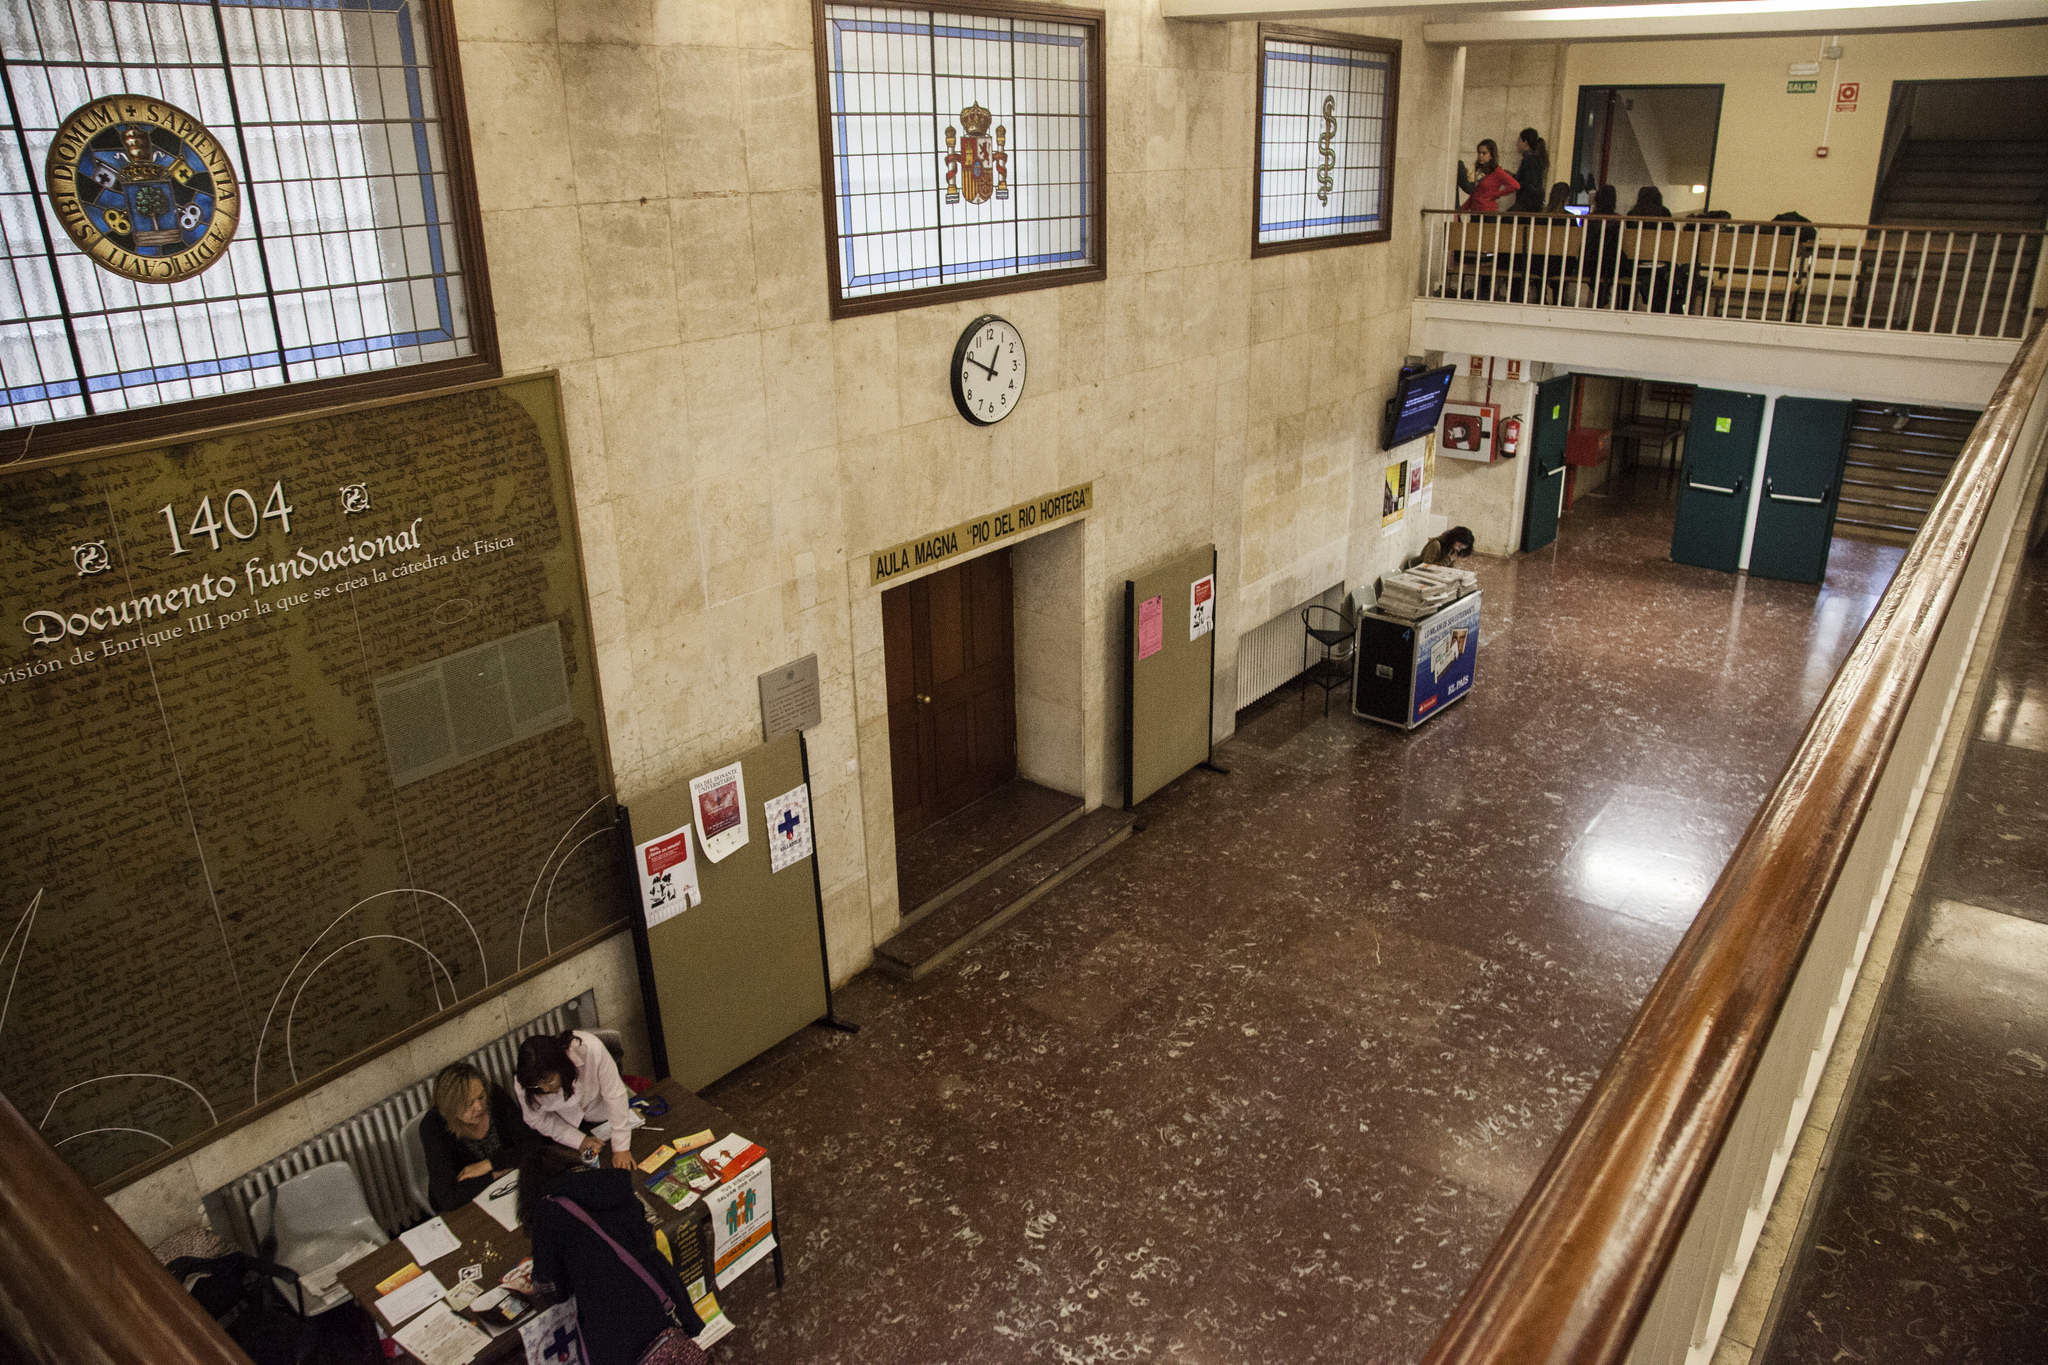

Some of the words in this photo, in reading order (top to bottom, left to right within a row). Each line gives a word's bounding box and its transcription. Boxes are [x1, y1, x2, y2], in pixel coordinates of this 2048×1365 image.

[1788, 82, 1817, 90] SALIDA
[54, 105, 114, 183] DOMUM
[147, 104, 235, 202] SAPIENTIA
[56, 191, 97, 241] SIBI
[157, 480, 293, 556] 1404
[876, 548, 910, 580] AULA
[914, 532, 958, 566] MAGNA
[995, 513, 1015, 538] DEL
[1019, 505, 1036, 529] RIO
[23, 573, 237, 645] Documento
[245, 518, 423, 595] fundacional
[0, 659, 65, 685] visión
[70, 647, 95, 666] de
[100, 624, 184, 657] Enrique
[188, 613, 212, 634] III
[219, 609, 250, 630] por
[254, 600, 271, 616] la
[276, 593, 309, 611] que
[314, 587, 331, 600] se
[335, 577, 368, 593] crea
[372, 568, 388, 584] la
[392, 552, 448, 578] cátedra
[451, 546, 470, 562] de
[473, 537, 515, 556] Física
[1402, 629, 1411, 641] 4
[1448, 683, 1455, 695] EL
[698, 775, 736, 793] UNIVERSITARIO
[703, 777, 713, 786] DEL
[713, 768, 738, 782] DONANTE
[717, 1188, 737, 1203] SALVAN
